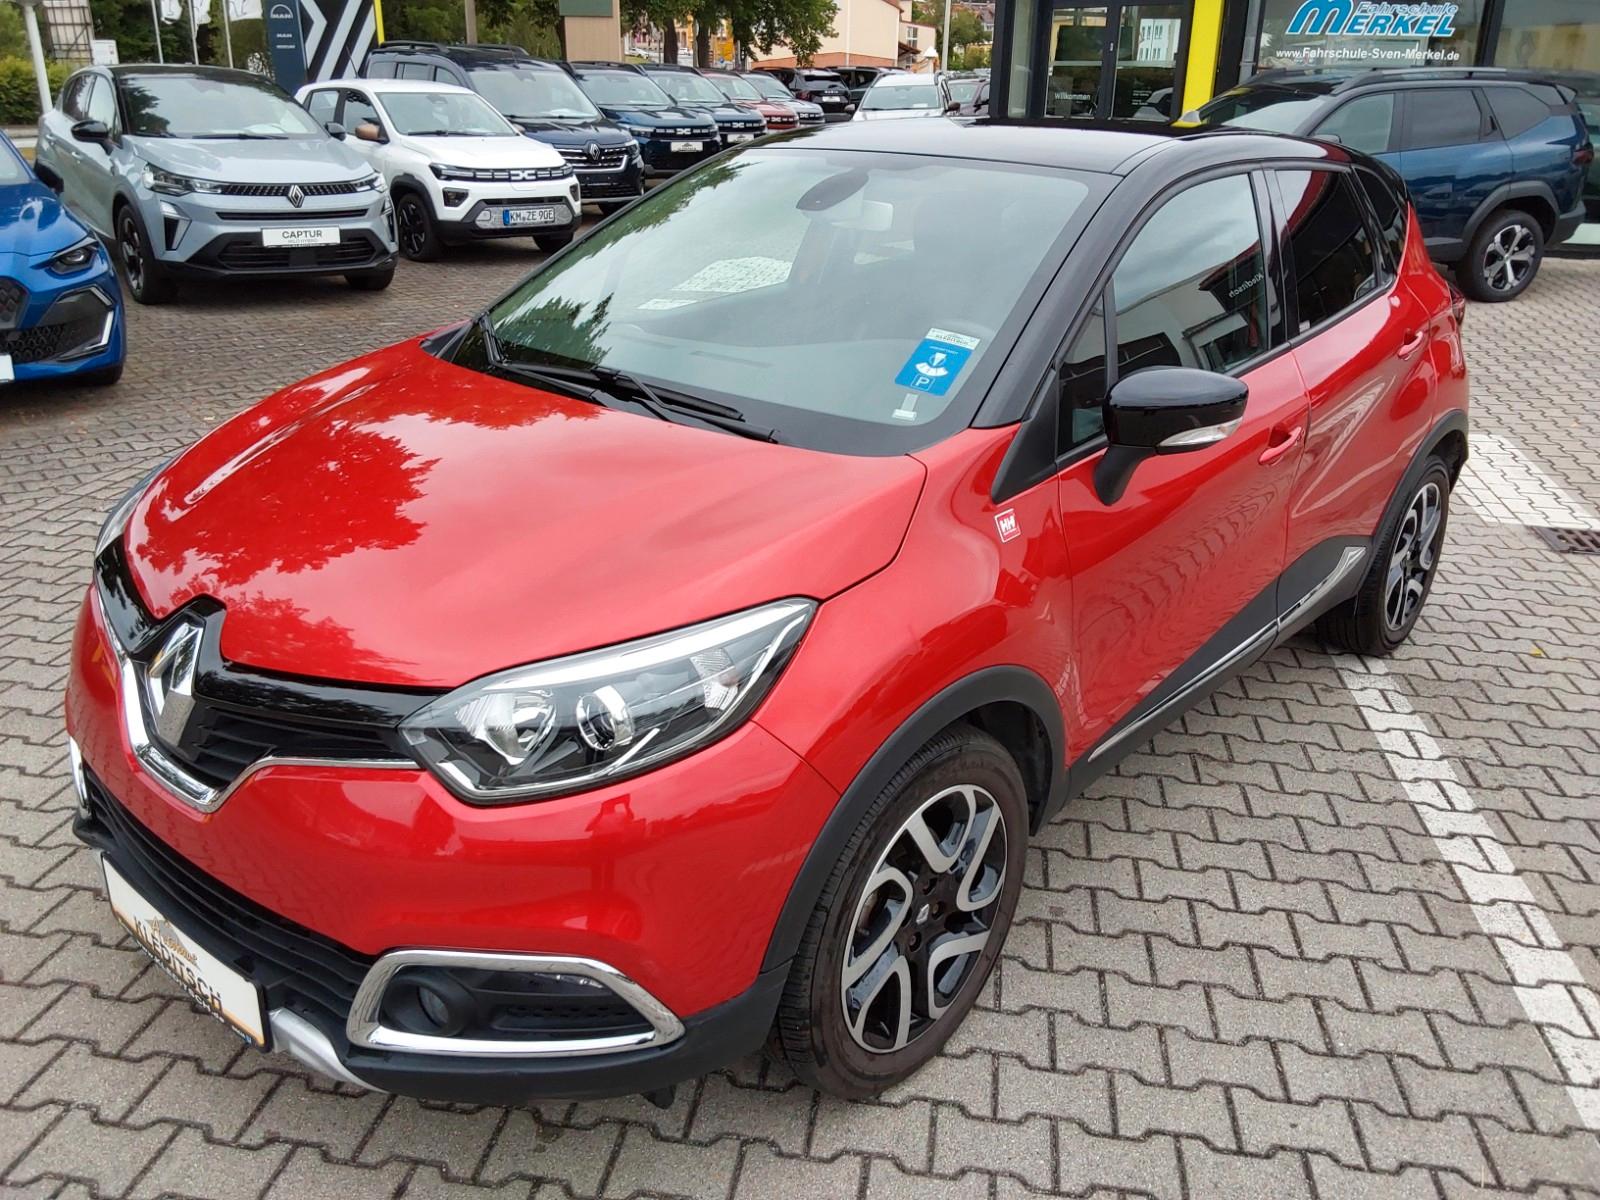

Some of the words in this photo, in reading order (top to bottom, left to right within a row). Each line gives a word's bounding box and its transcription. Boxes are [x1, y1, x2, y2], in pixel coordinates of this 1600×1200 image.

[1356, 1, 1458, 15] Fahrschule
[1285, 0, 1458, 37] MERKEL
[1275, 45, 1461, 62] www.Fahrschule-Sven-Merkel.de
[1054, 91, 1091, 101] Willkommen
[511, 211, 522, 222] KM
[527, 210, 537, 221] ZE
[282, 230, 322, 239] CAPTUR
[915, 376, 930, 386] P
[133, 914, 224, 1016] KLEDITSCH
